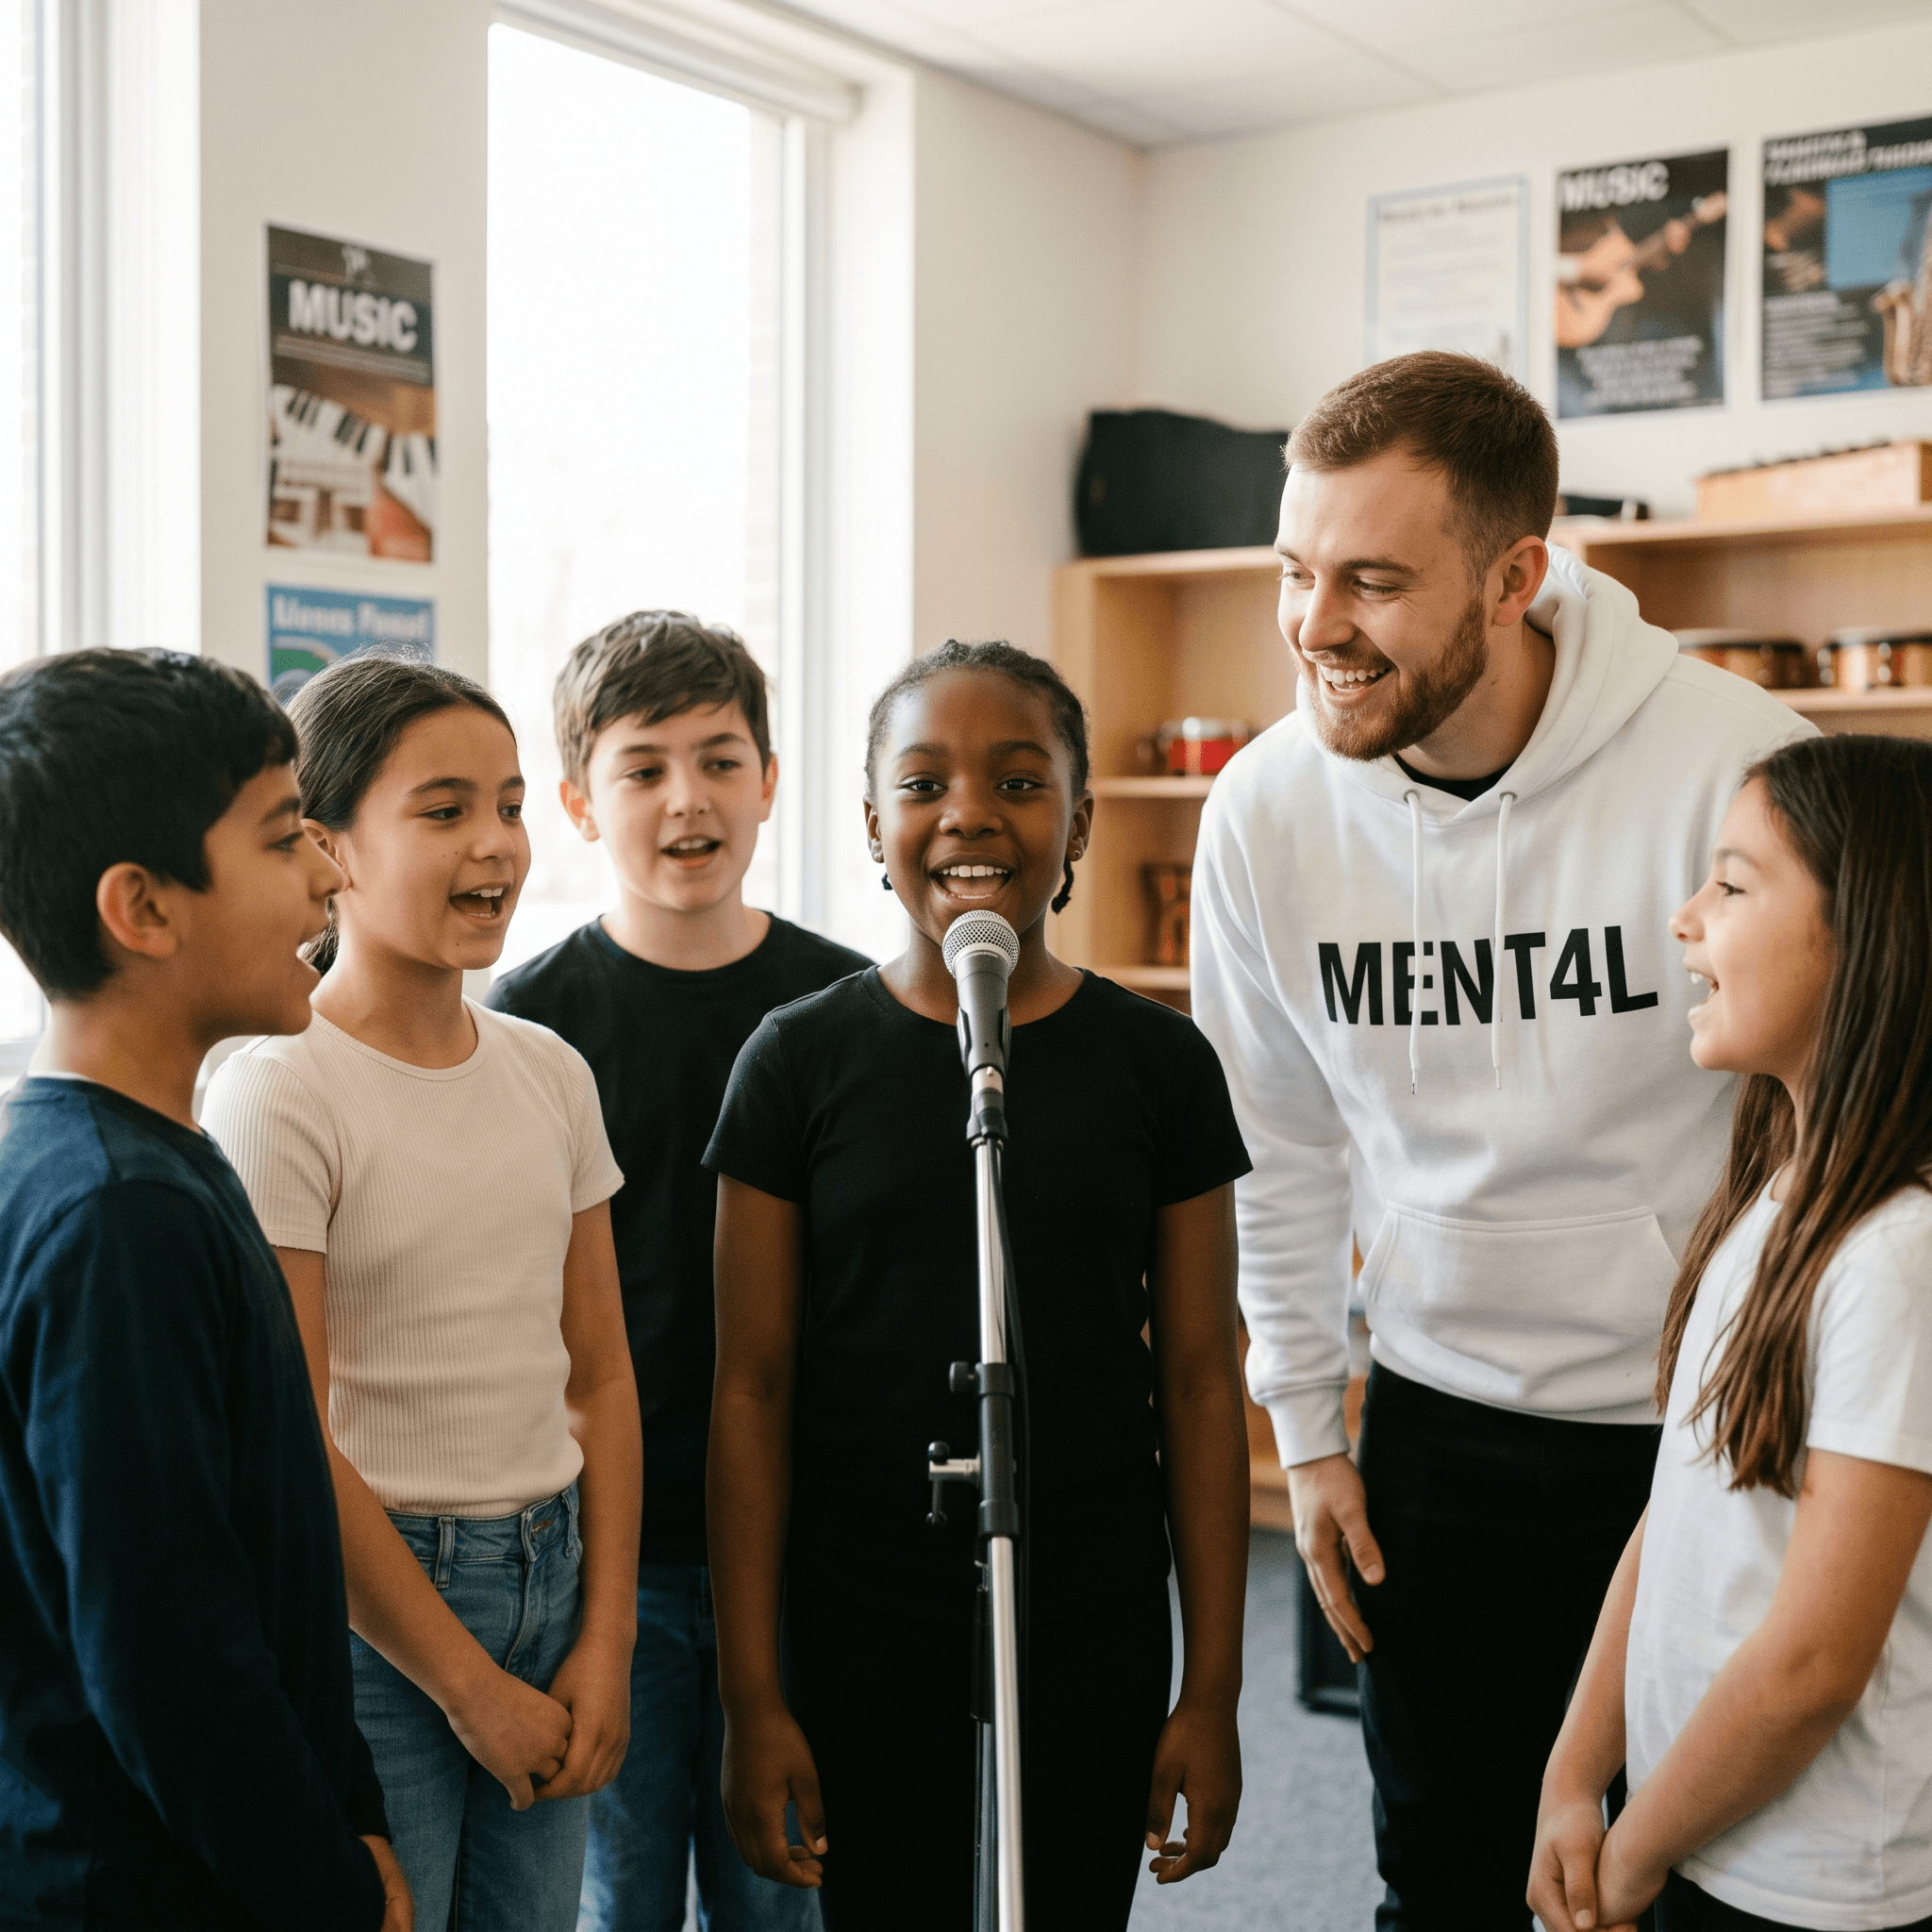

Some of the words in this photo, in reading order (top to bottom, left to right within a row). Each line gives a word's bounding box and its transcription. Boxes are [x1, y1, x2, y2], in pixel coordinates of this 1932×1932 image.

[1558, 160, 1669, 210] MUSIC
[289, 279, 417, 352] MUSIC
[1318, 925, 1658, 1026] MENT4L
